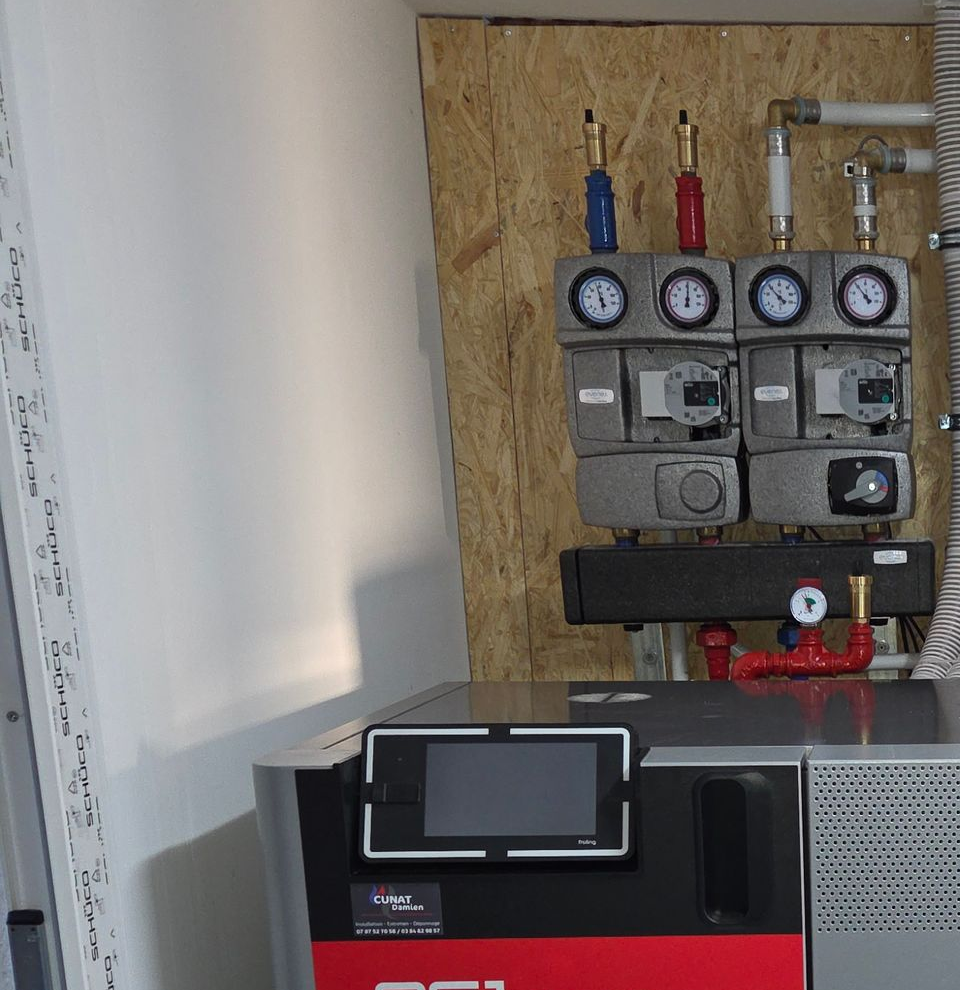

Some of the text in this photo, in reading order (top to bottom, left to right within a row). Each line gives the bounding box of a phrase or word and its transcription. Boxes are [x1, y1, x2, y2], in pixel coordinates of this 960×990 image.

[9, 247, 31, 352] SCHÜCO
[17, 395, 38, 497] SCHÜCO
[43, 498, 64, 596] SCHÜCO
[51, 640, 71, 736] SCHÜCO
[75, 734, 94, 827] SCHÜCO
[81, 870, 100, 961] SCHÜCO
[373, 895, 412, 904] CUNAT
[391, 903, 424, 911] Damien
